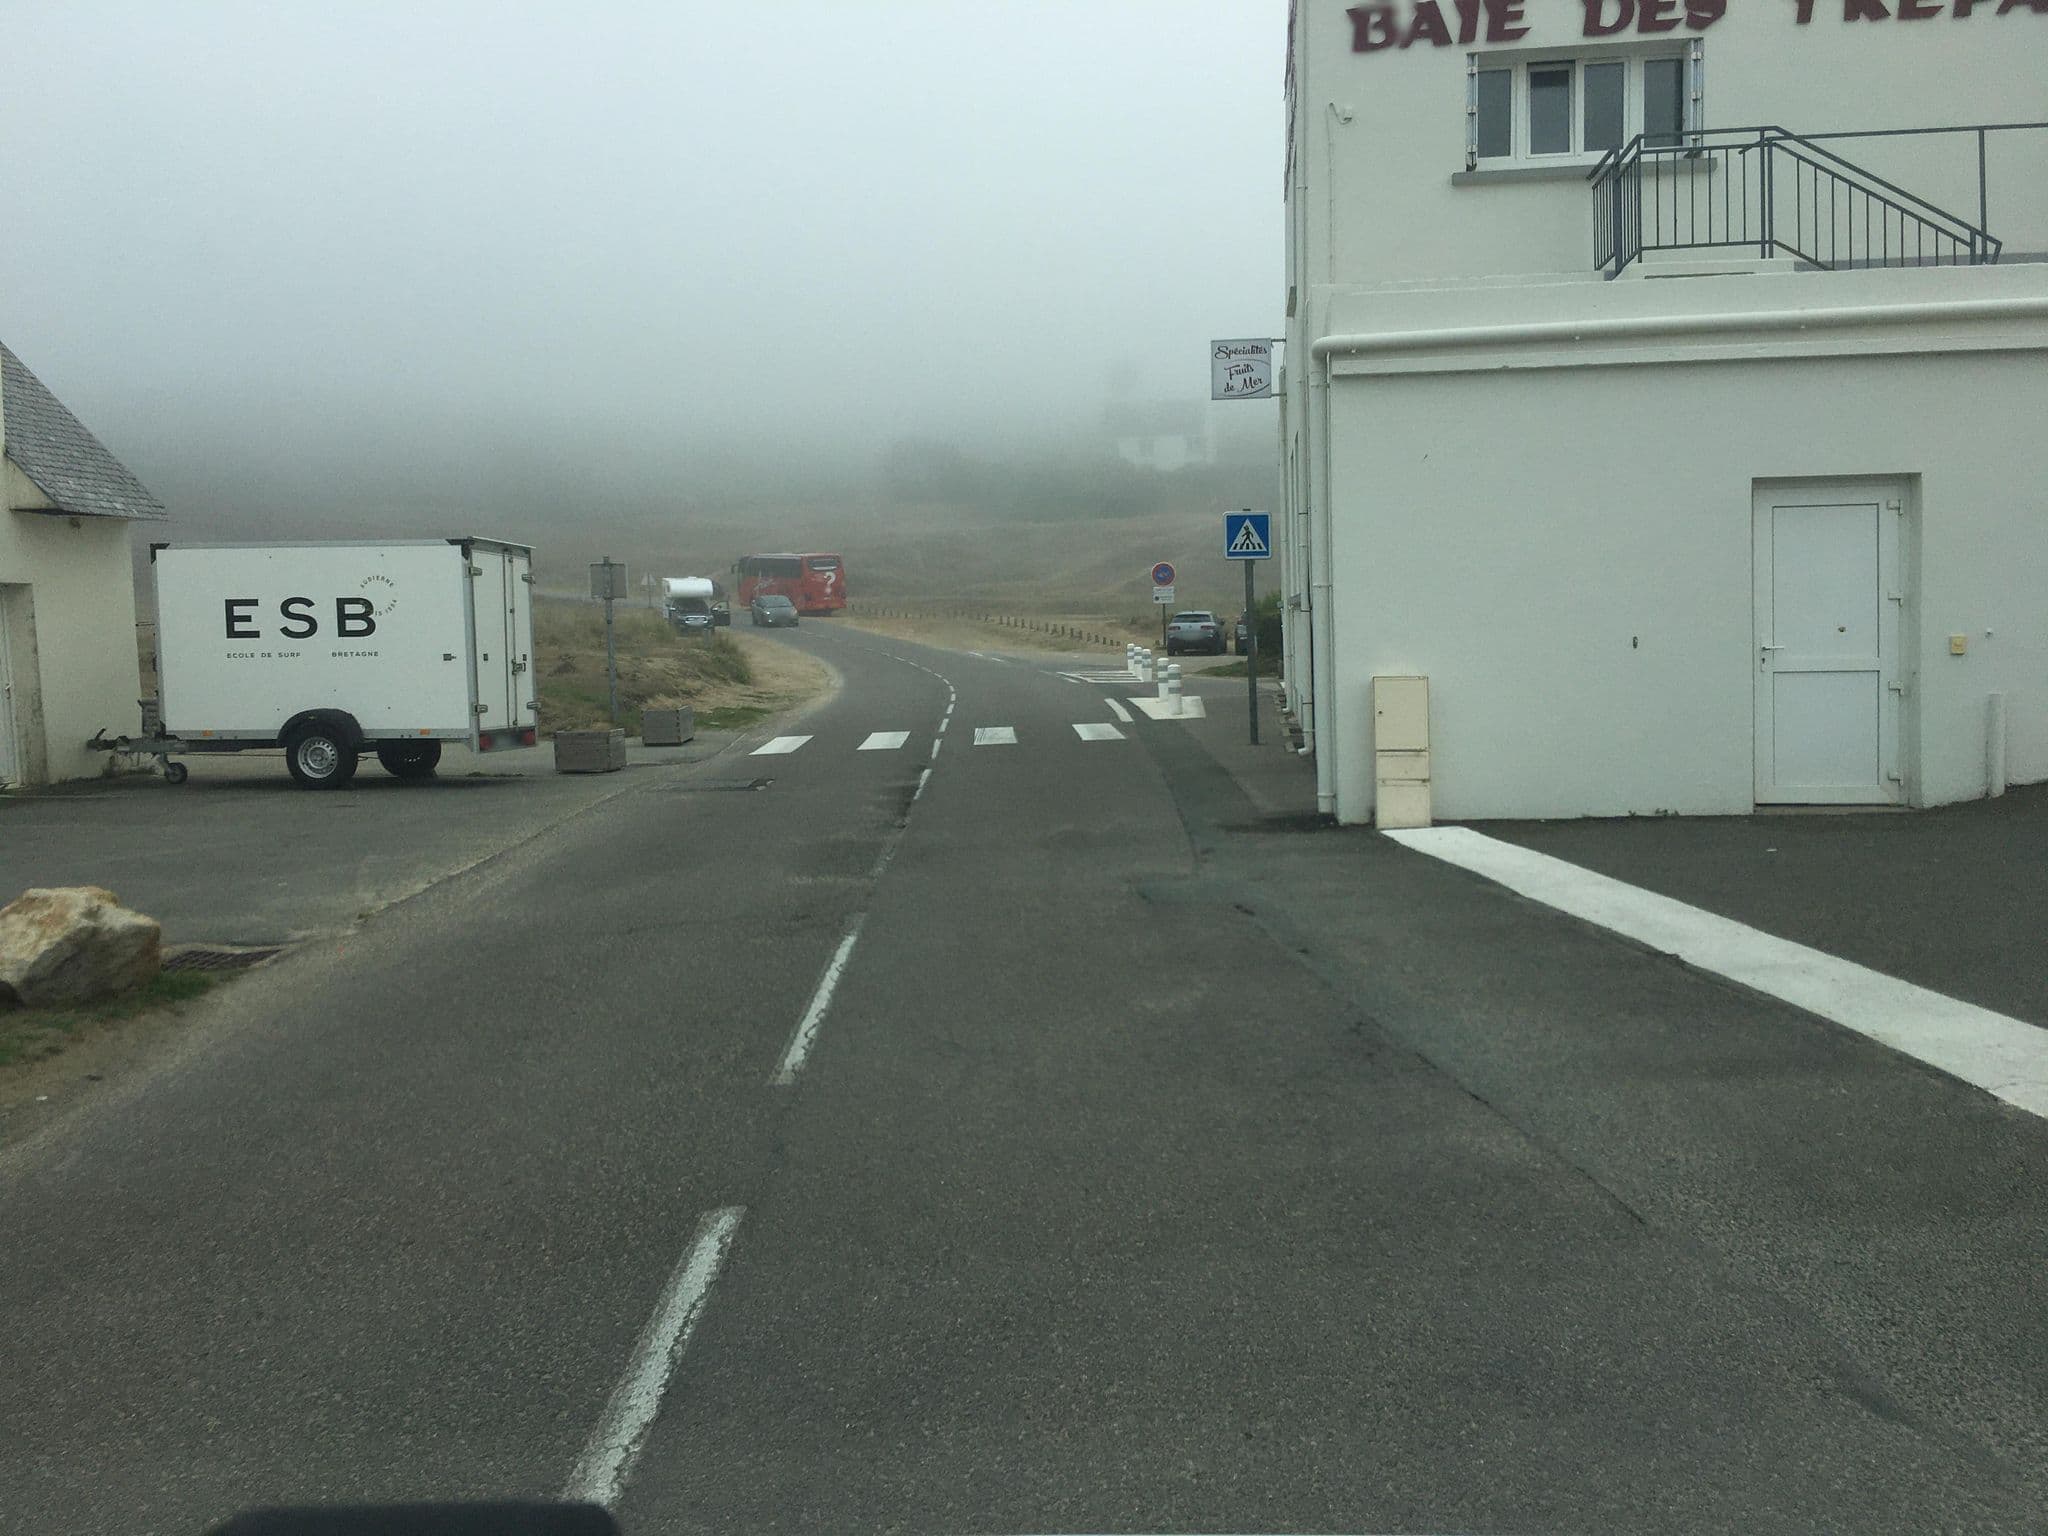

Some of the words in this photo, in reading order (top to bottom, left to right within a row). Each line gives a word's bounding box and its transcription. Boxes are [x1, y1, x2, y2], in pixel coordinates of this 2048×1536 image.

[1346, 0, 1531, 53] BAIE
[1583, 0, 1728, 37] DES
[1223, 363, 1255, 380] Fruits
[1224, 382, 1234, 393] de
[1237, 376, 1263, 393] Mer
[225, 597, 377, 639] ESB
